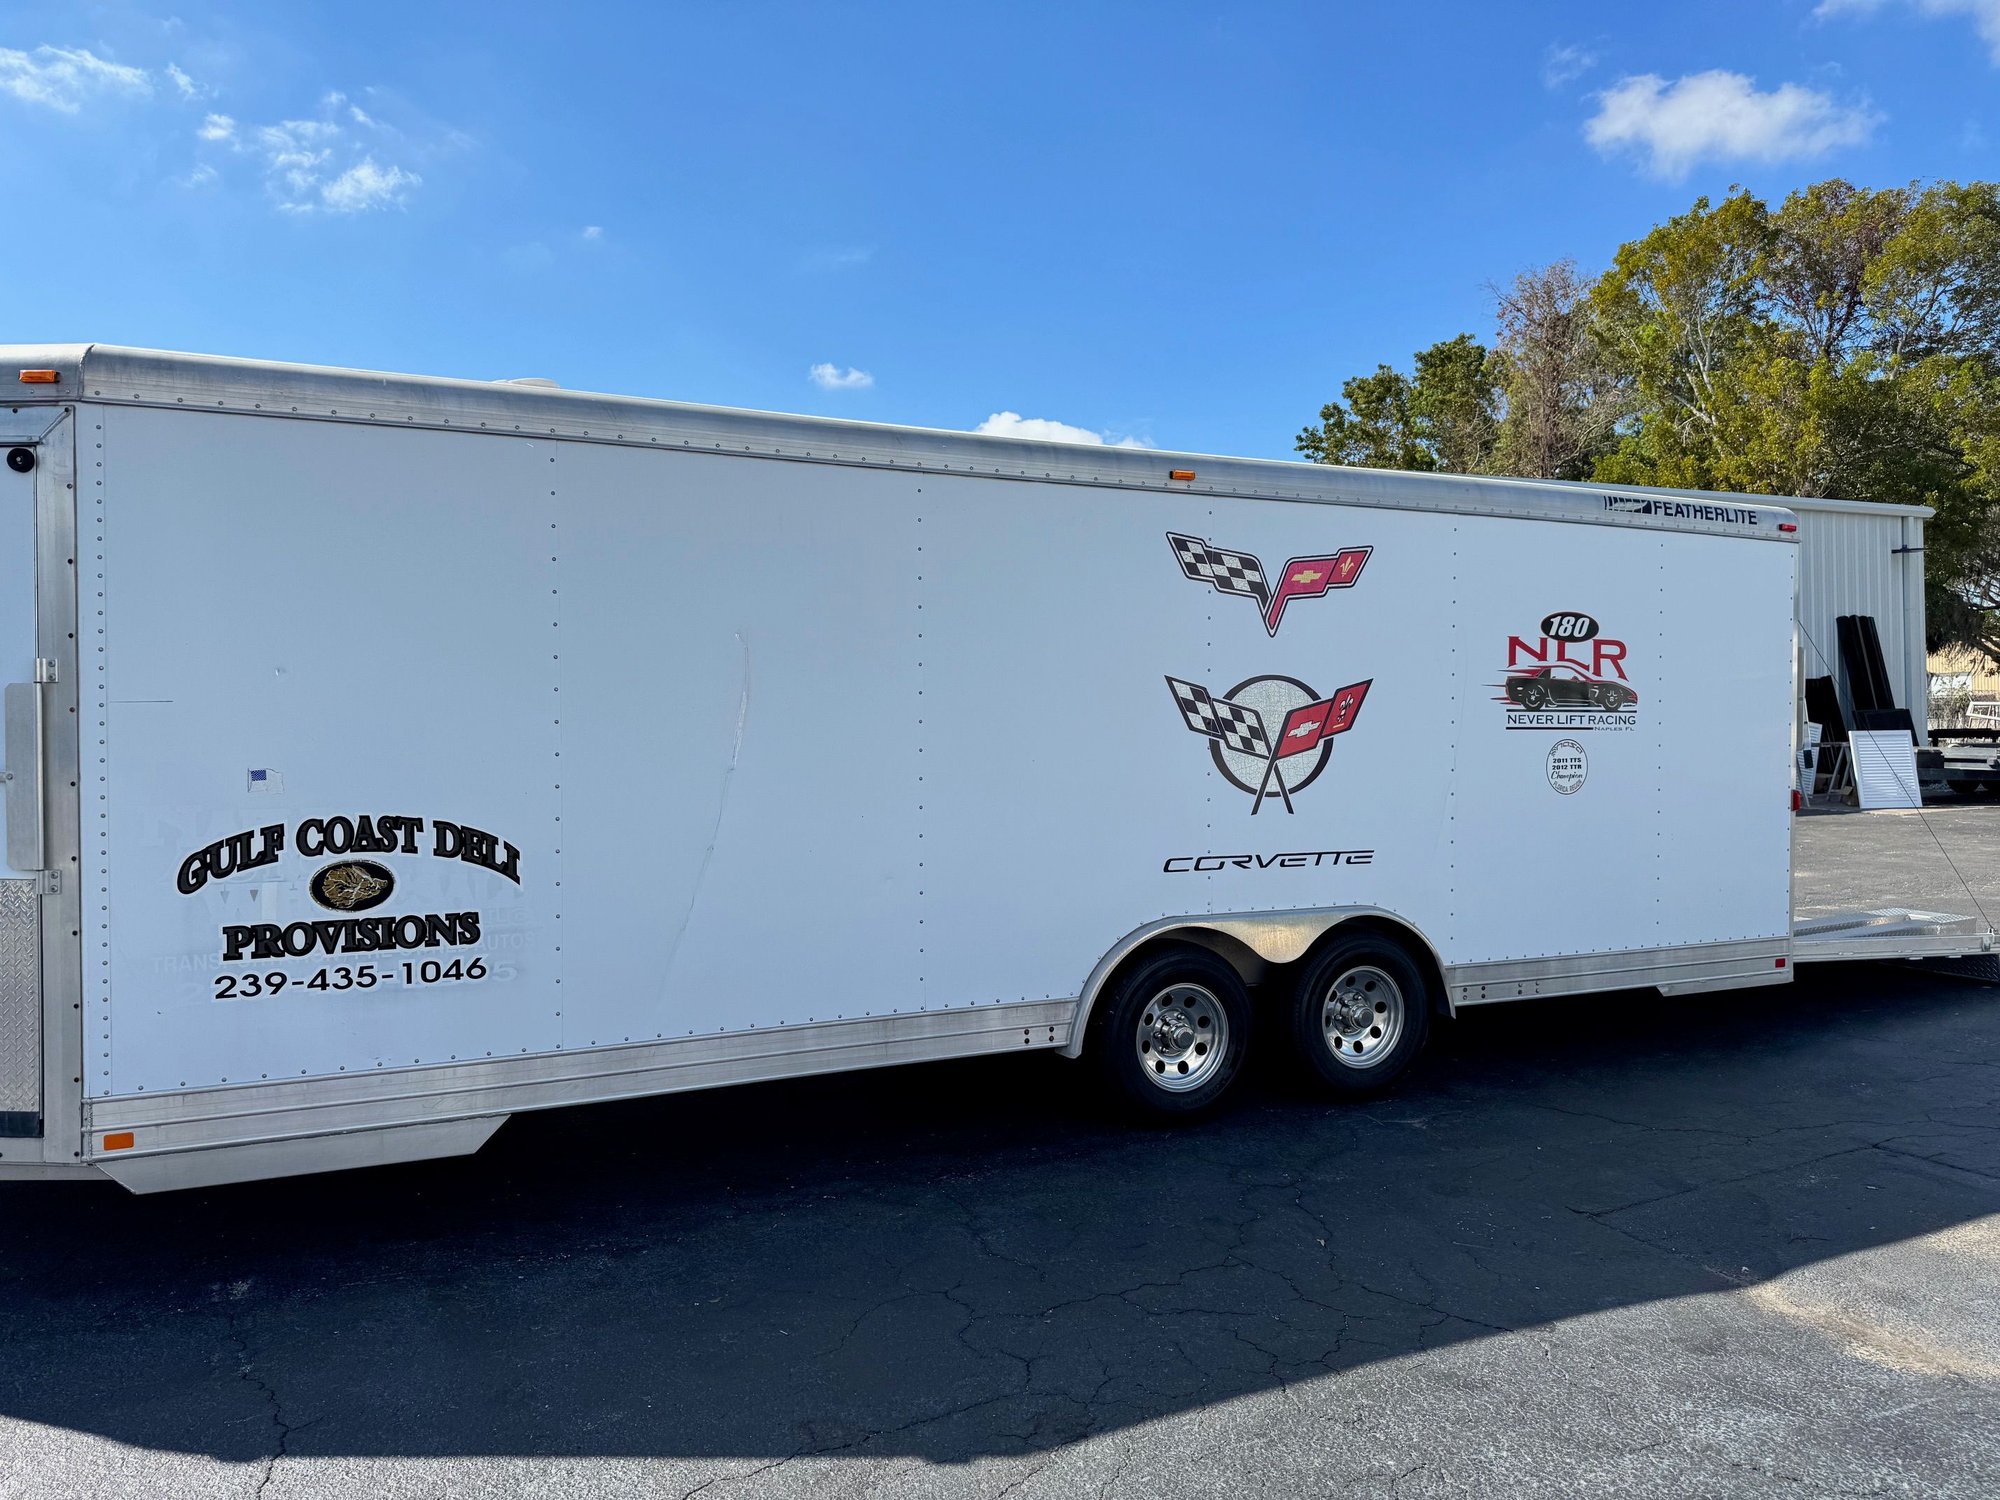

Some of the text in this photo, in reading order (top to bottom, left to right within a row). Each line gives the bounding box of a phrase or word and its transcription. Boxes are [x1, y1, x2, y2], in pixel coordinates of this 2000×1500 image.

[1653, 501, 1758, 525] FEATHERLITE
[1548, 616, 1590, 638] 180
[1507, 635, 1630, 682] NLR
[1507, 714, 1637, 725] NEVER LIFT RACING
[1550, 770, 1583, 782] Champion
[176, 815, 521, 895] GULF COAST DELI
[1162, 850, 1375, 873] CORVETTE
[222, 912, 481, 961] PROVISIONS
[214, 958, 488, 999] 239-435-1046
